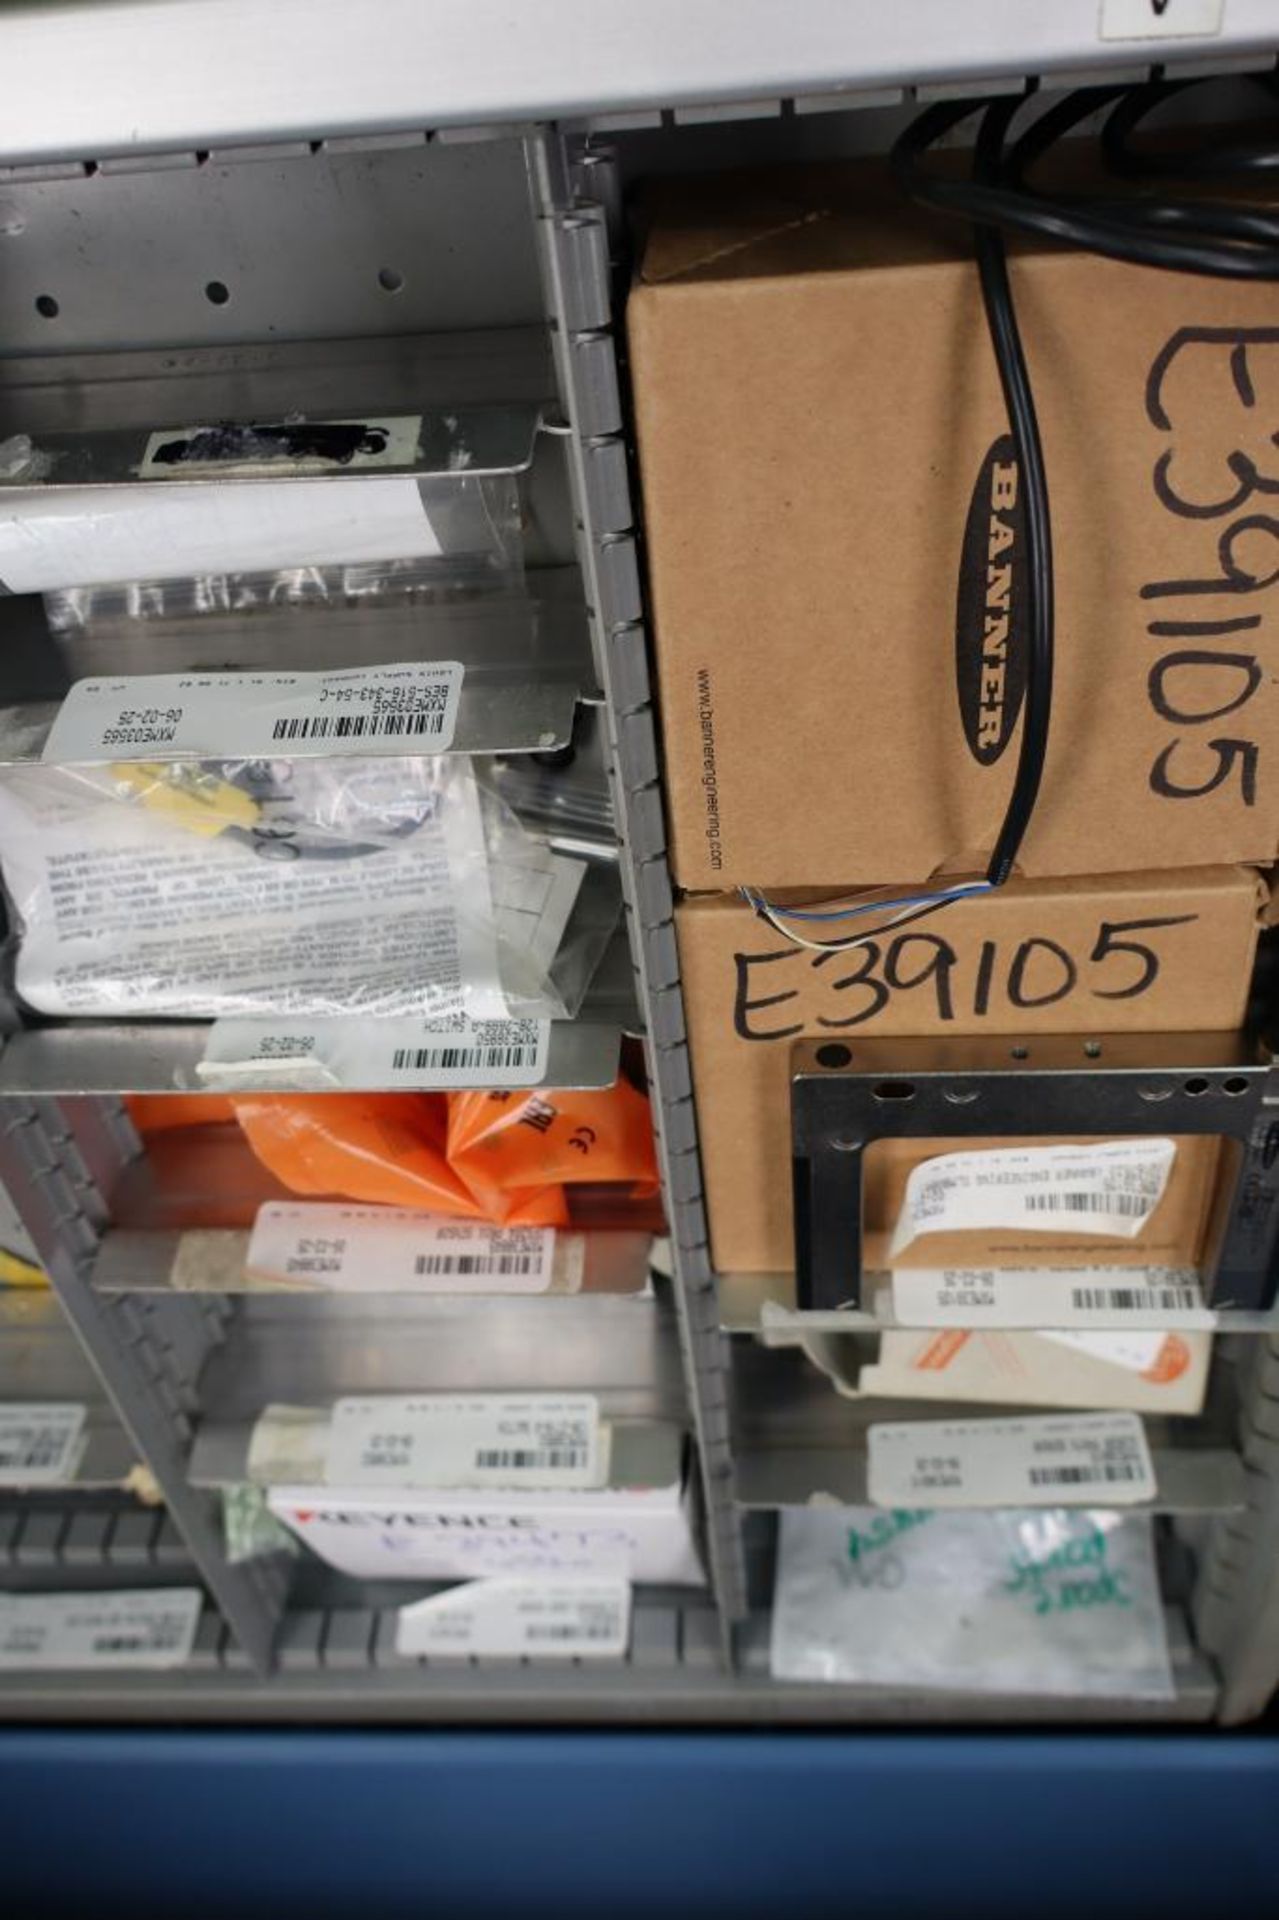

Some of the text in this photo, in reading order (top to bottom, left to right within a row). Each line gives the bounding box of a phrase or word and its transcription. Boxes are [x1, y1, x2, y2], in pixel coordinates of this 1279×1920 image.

[1140, 327, 1279, 806] E39105
[977, 461, 1018, 750] BANNER
[118, 708, 183, 726] 06-02-25
[319, 684, 449, 701] BES-516-343-54-C
[372, 698, 446, 714] MXME03565
[101, 726, 176, 744] MXME03565
[697, 668, 723, 870] www.bannerengineering.com
[734, 914, 1198, 1040] E39105
